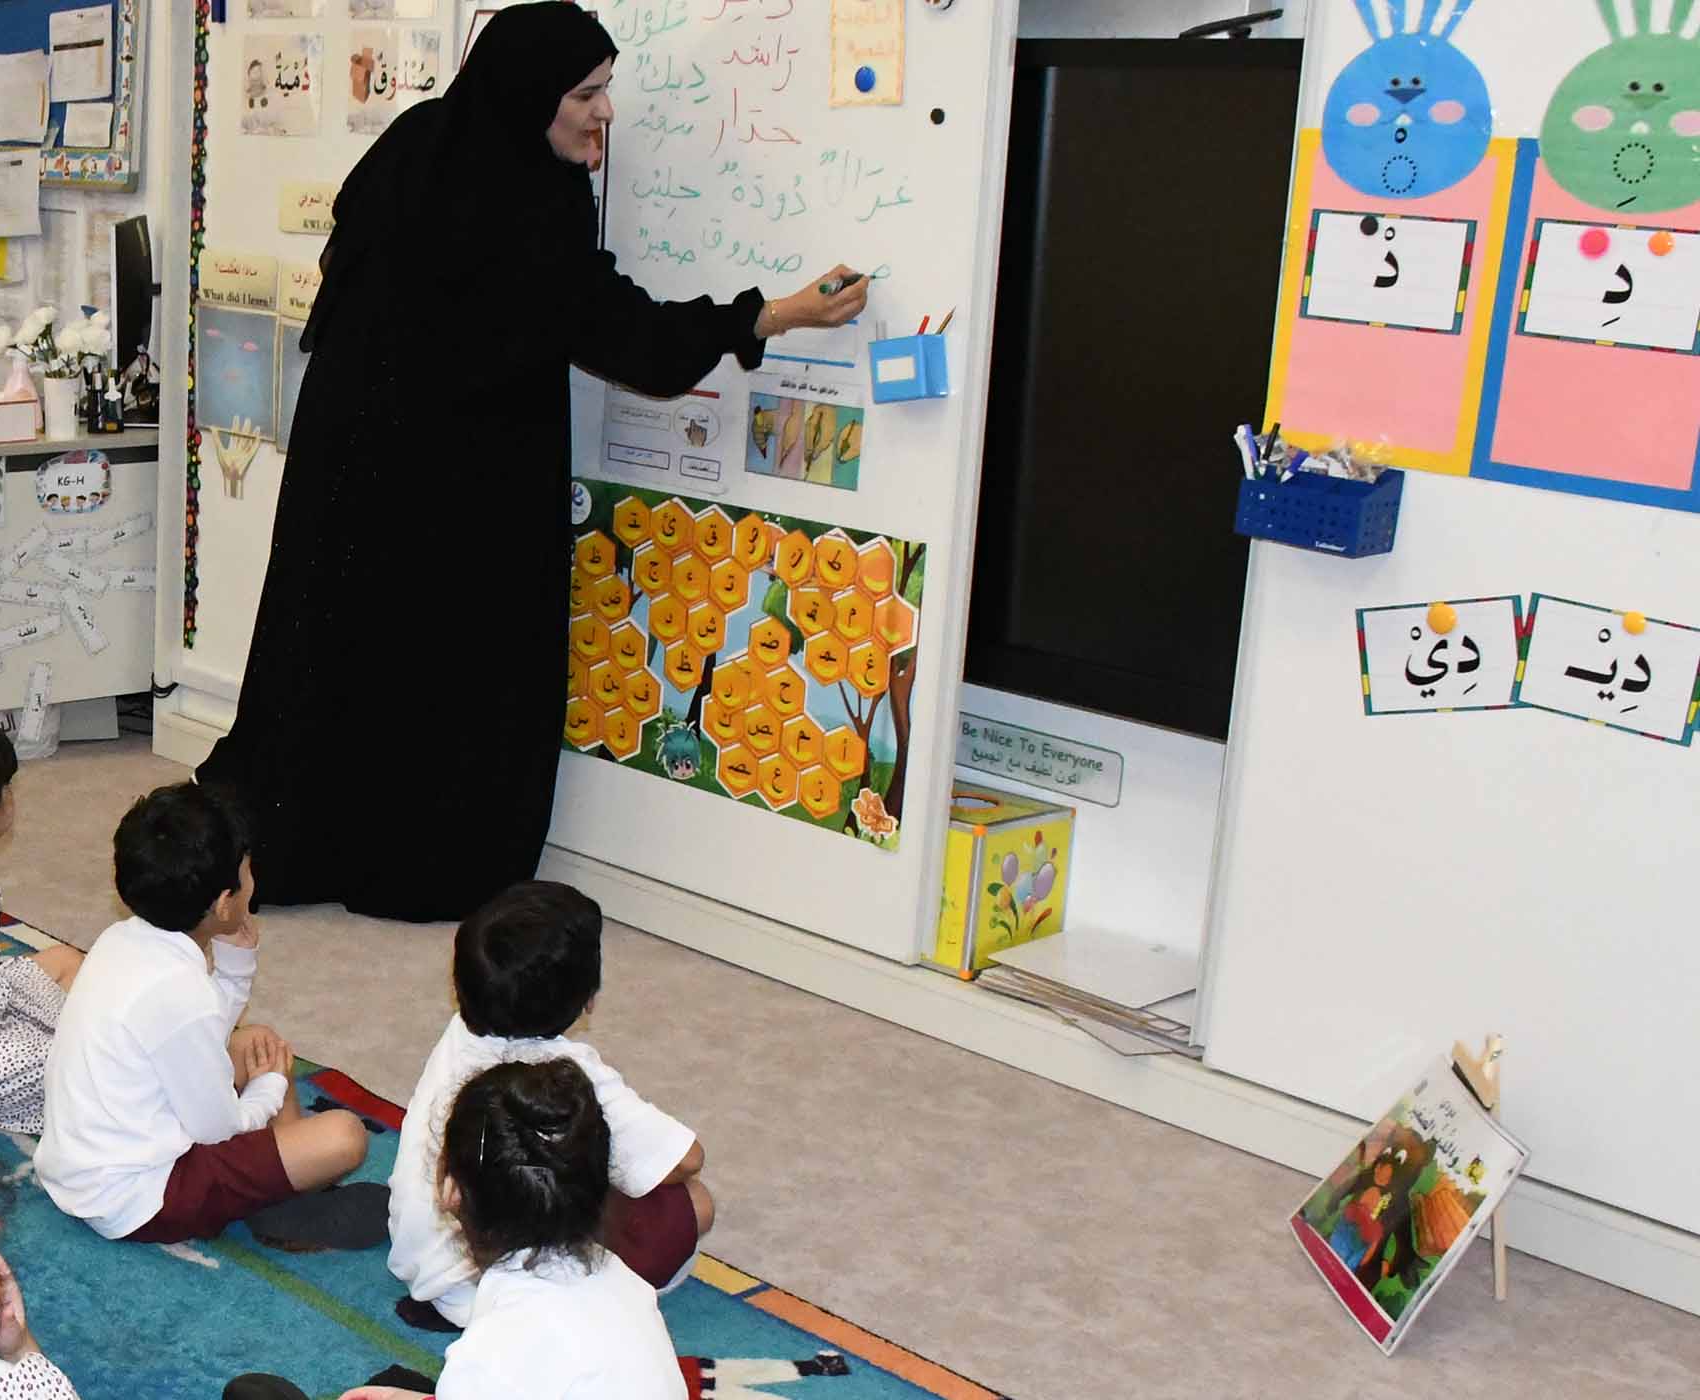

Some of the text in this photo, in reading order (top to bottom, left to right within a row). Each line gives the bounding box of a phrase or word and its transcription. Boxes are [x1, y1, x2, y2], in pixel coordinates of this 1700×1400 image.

[202, 287, 224, 301] What
[226, 291, 241, 303] did
[57, 475, 85, 488] KG-H
[962, 721, 1104, 772] Be Nice To Everyone
